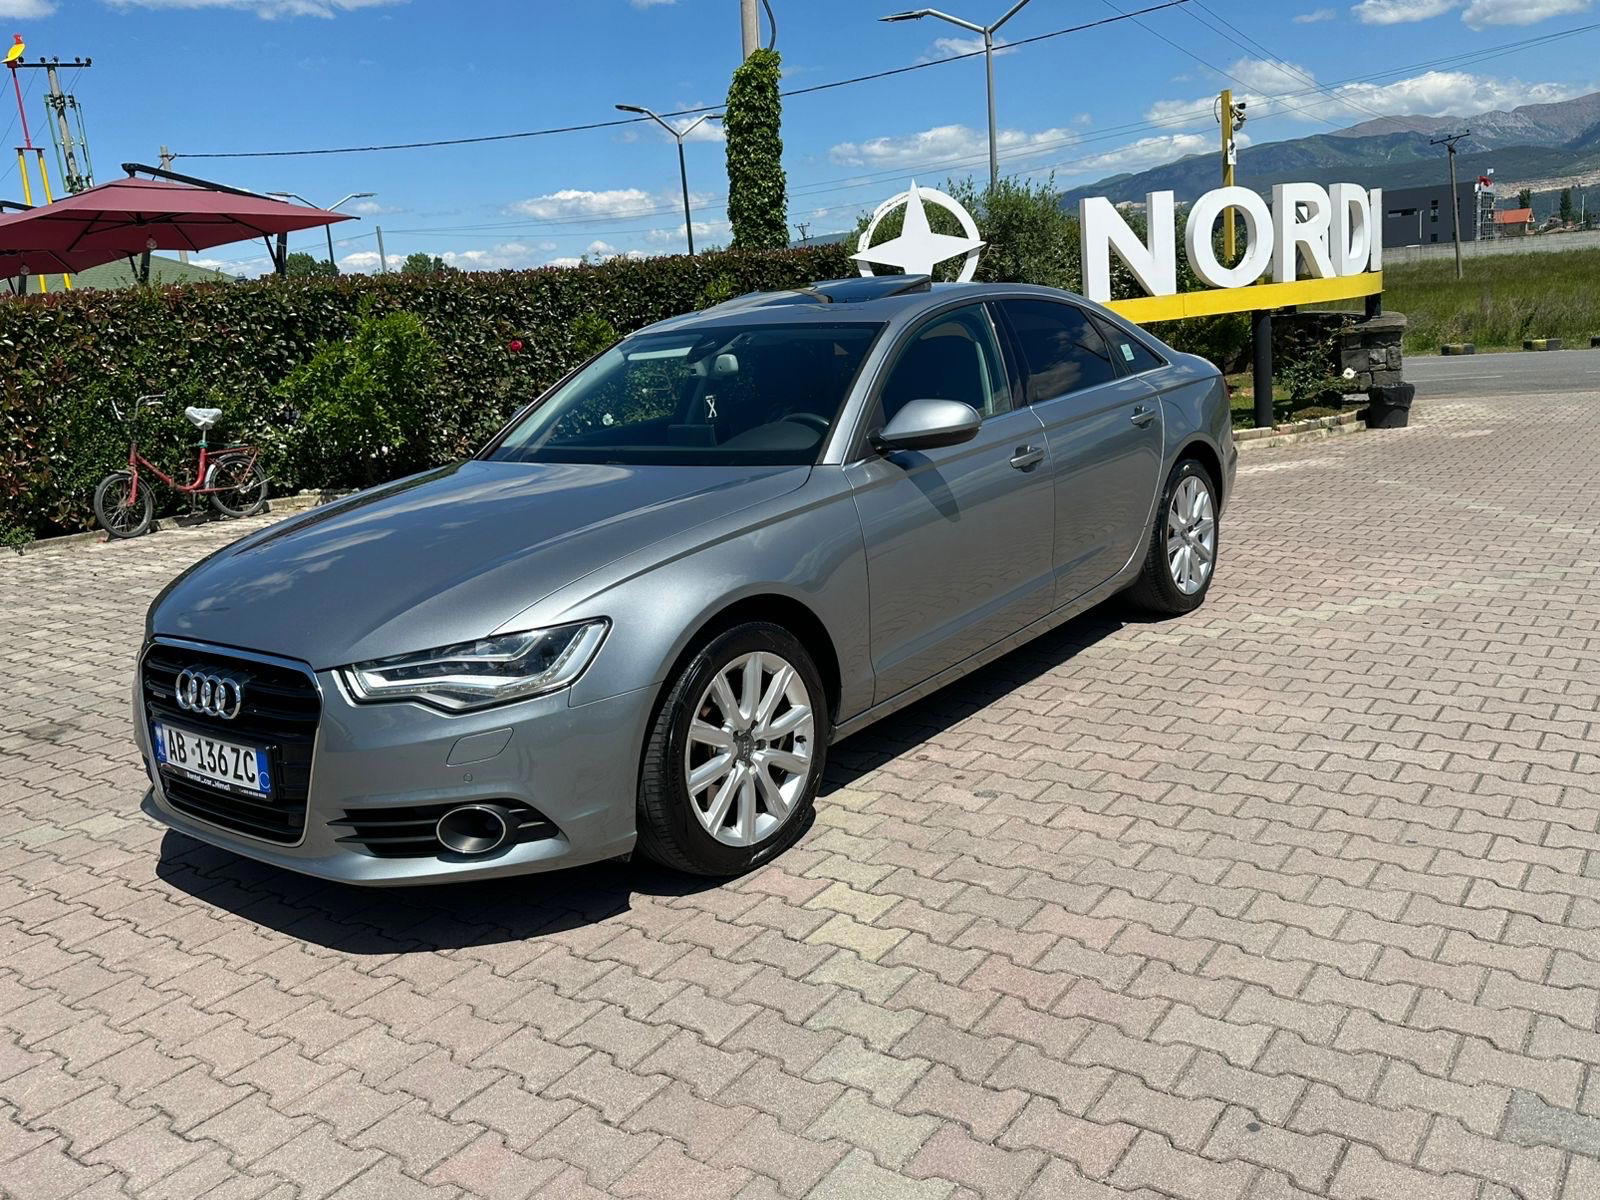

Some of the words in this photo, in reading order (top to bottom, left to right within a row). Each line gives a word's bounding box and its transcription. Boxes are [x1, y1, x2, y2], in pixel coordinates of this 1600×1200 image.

[1080, 182, 1383, 303] NORDI
[168, 729, 187, 764] AB
[195, 738, 229, 777] 136
[231, 747, 256, 783] ZC
